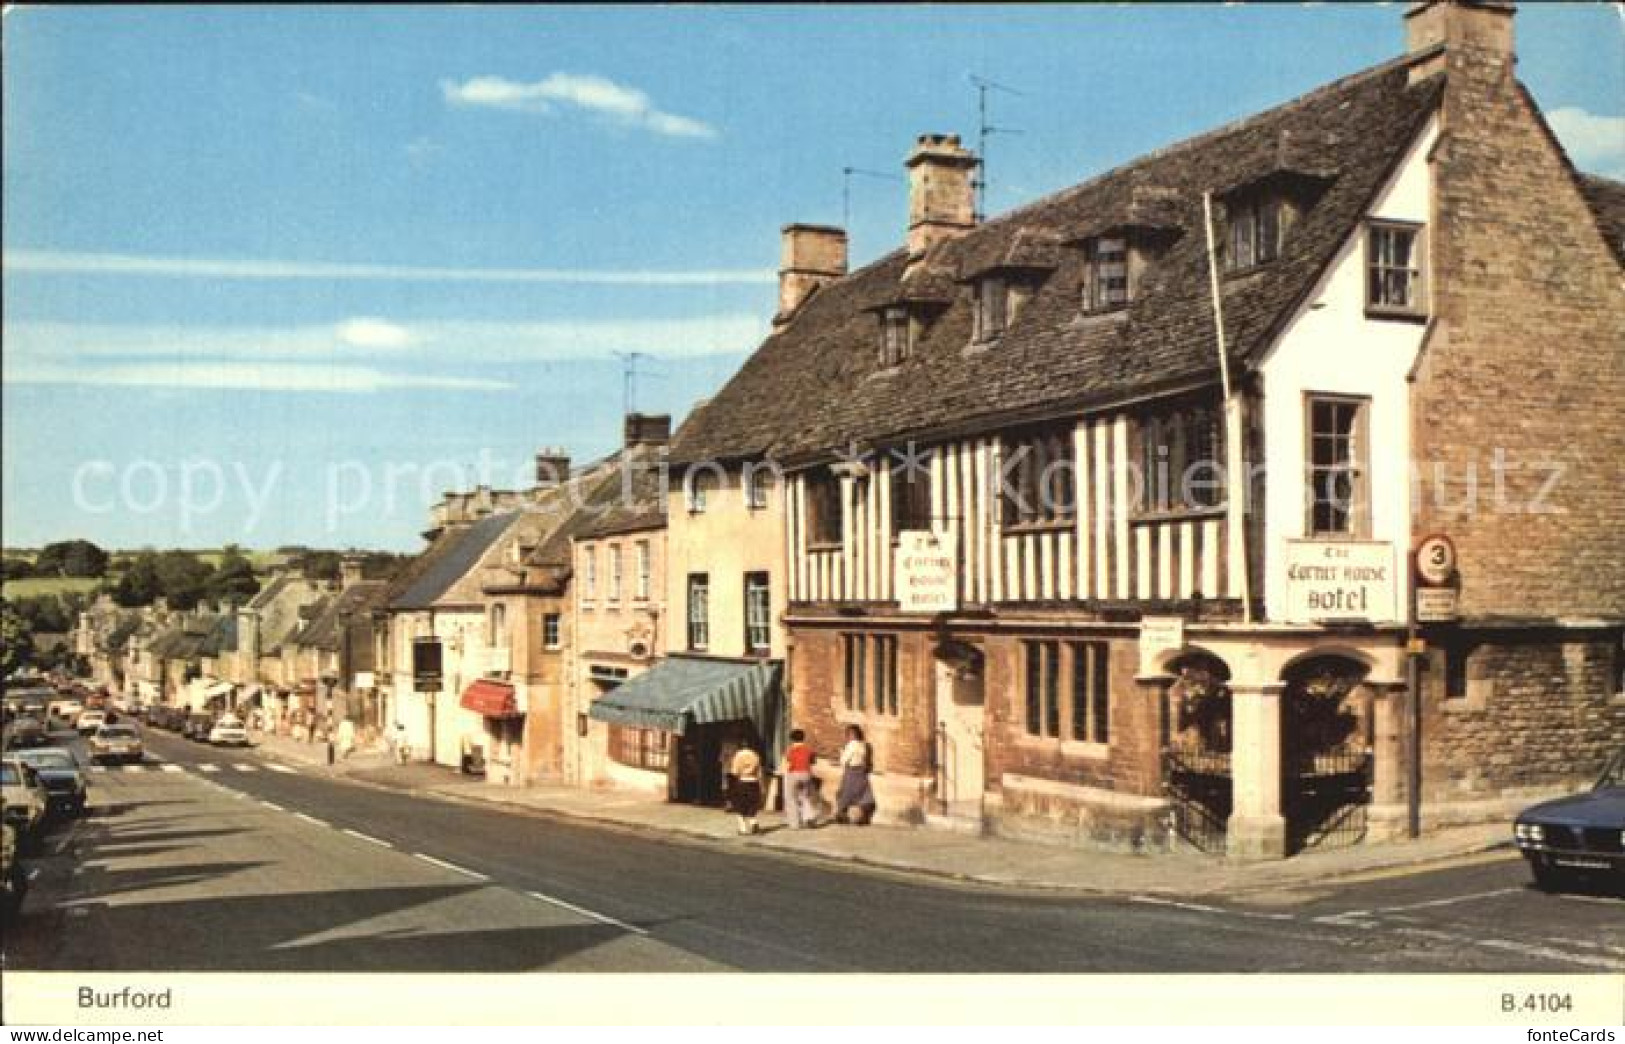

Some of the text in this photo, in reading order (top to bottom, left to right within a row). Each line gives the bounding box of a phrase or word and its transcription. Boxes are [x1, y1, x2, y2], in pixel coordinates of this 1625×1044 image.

[1431, 544, 1447, 565] 3
[78, 986, 171, 1008] Burford
[1501, 993, 1572, 1013] B.4104
